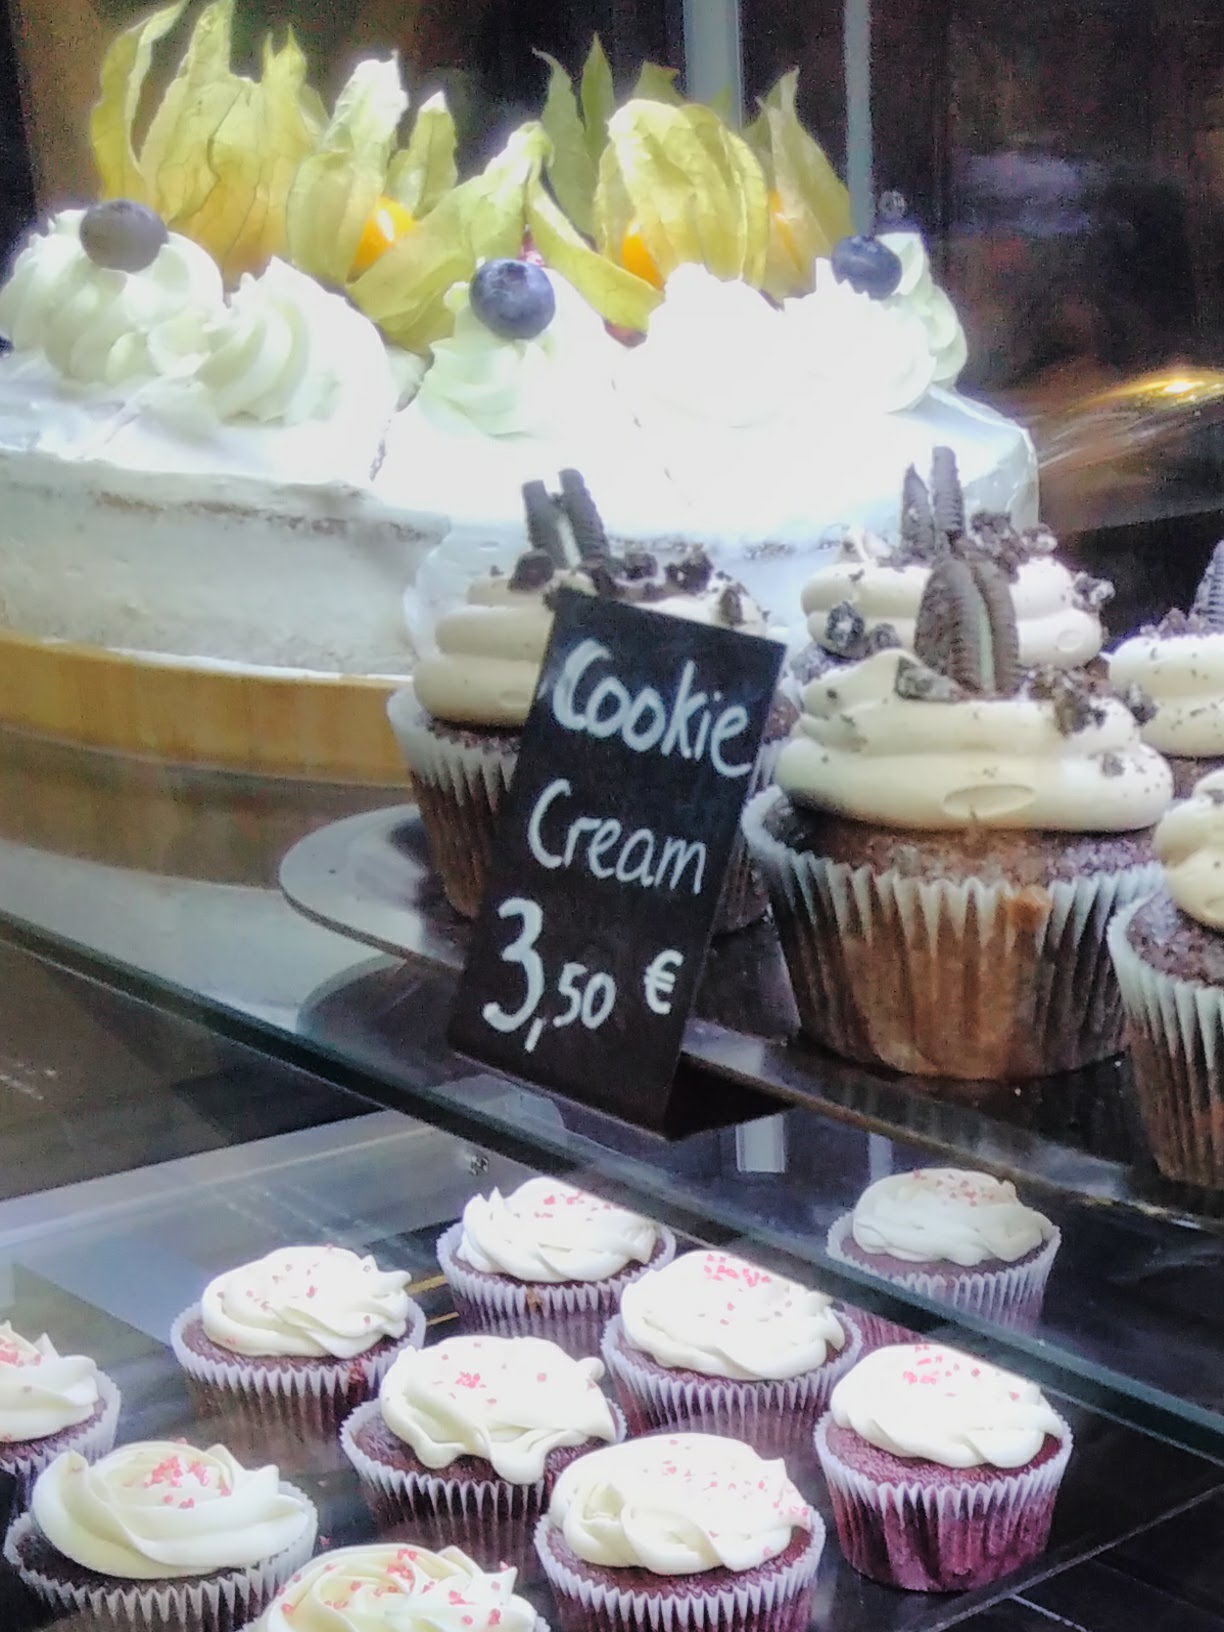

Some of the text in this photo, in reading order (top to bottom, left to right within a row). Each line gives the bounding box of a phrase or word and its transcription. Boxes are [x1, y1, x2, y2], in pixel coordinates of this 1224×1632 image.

[550, 637, 754, 778] Cookie
[527, 777, 707, 896] Cream
[481, 896, 685, 1055] 3,50 €
